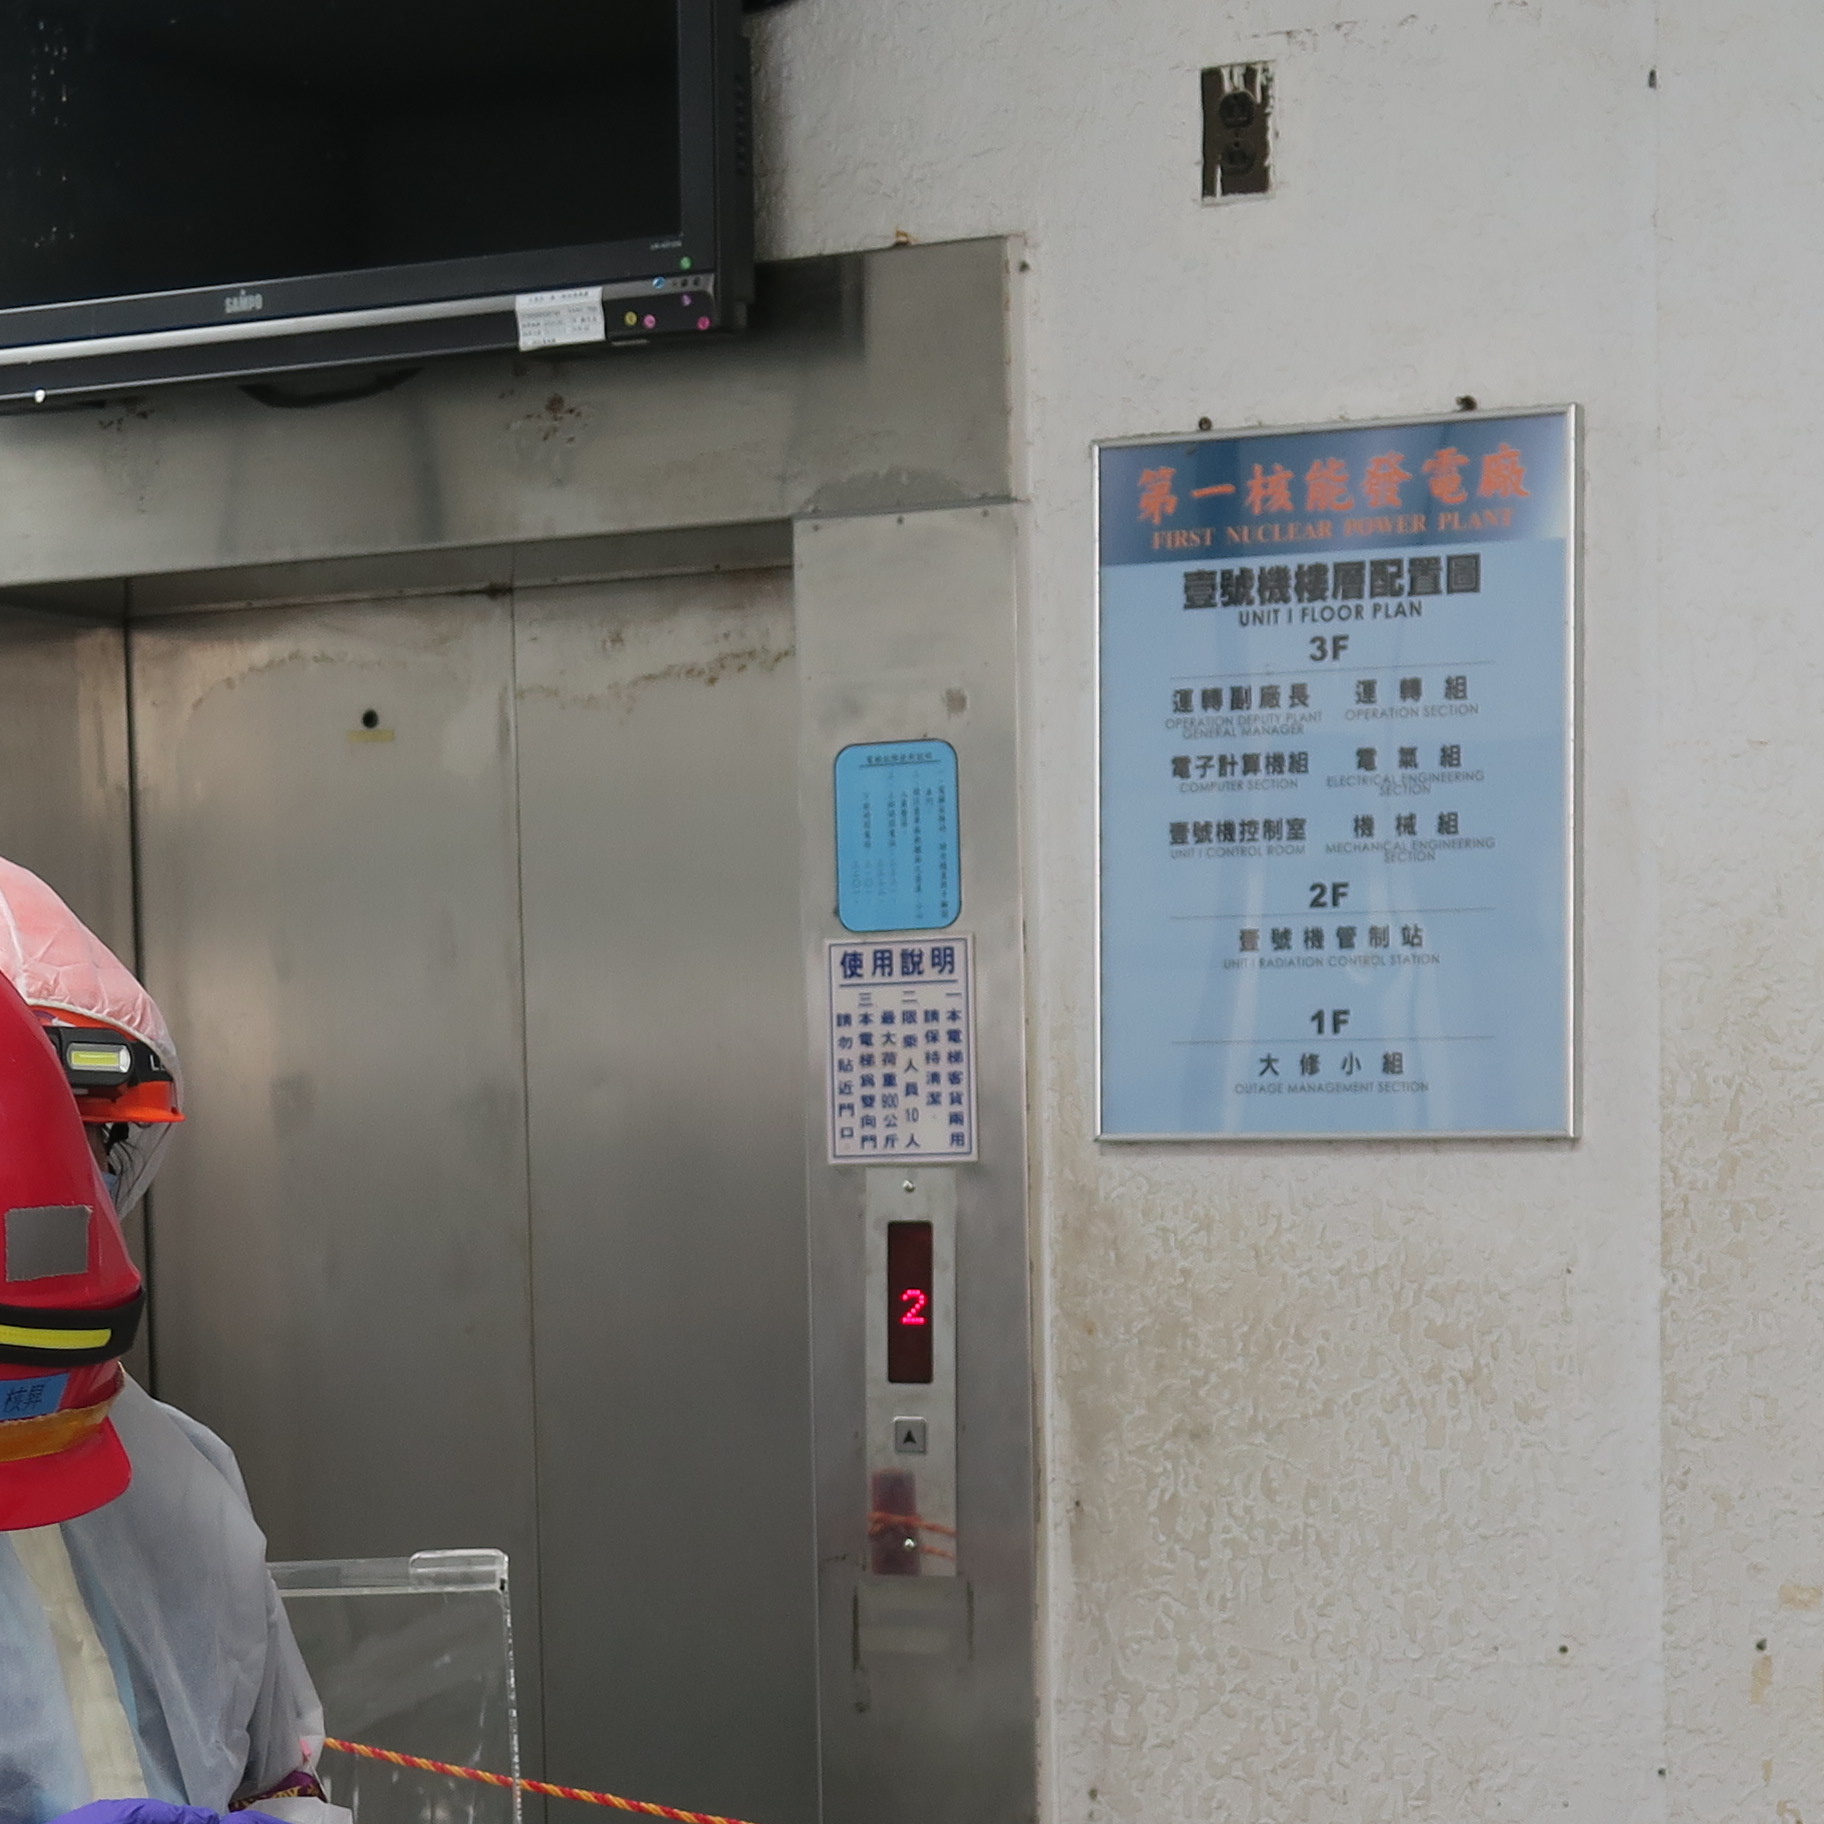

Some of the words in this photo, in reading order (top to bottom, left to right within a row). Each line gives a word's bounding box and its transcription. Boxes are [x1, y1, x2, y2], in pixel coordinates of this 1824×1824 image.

[1138, 443, 1530, 524] 第一核能發電廠
[1152, 528, 1214, 549] FIRST
[1227, 521, 1332, 545] NUCLEAR
[1344, 514, 1426, 537] POWER
[1439, 508, 1514, 531] PLANT
[1183, 553, 1481, 610] 壹號機樓層配置圖
[1239, 607, 1281, 627] UNIT
[1301, 603, 1364, 622] FLOOR
[1372, 600, 1422, 619] PLAN
[1309, 634, 1350, 662] 3F
[1173, 682, 1310, 713] 運轉副廠長
[1356, 675, 1468, 704] 運轉組
[1344, 705, 1419, 722] OPERATION
[1424, 703, 1480, 719] SECTION
[1247, 778, 1299, 791] SECTION
[1308, 881, 1350, 908] 2F
[840, 946, 955, 979] 使用說明
[1310, 1009, 1350, 1035] 1F
[1259, 1051, 1404, 1077] 大修小組
[1287, 1081, 1375, 1094] MANAGEMENT
[1378, 1080, 1430, 1093] SECTION
[900, 1288, 928, 1326] 2
